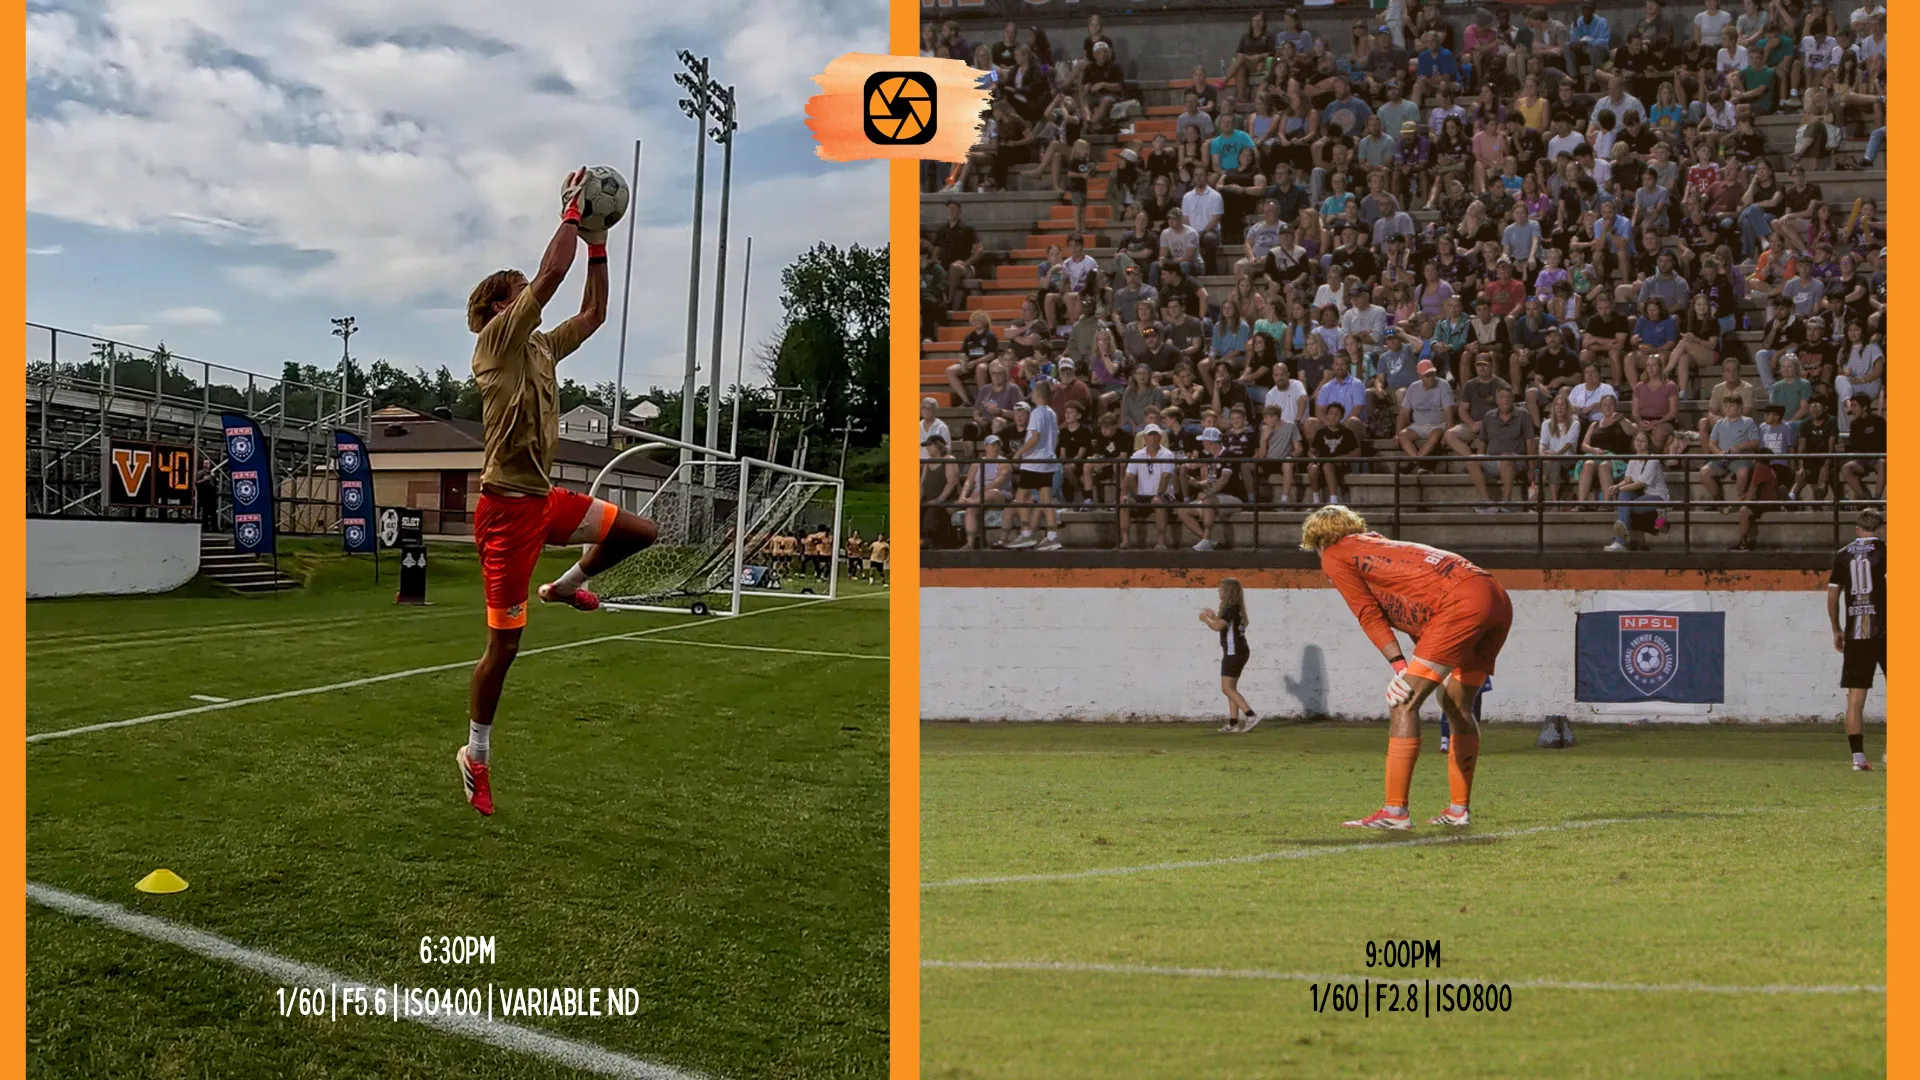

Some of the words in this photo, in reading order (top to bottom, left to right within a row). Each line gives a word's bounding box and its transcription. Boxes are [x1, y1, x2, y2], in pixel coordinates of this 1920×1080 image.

[112, 448, 151, 497] V
[158, 451, 189, 490] 40
[1850, 557, 1873, 595] 10
[1625, 618, 1672, 628] NPSL
